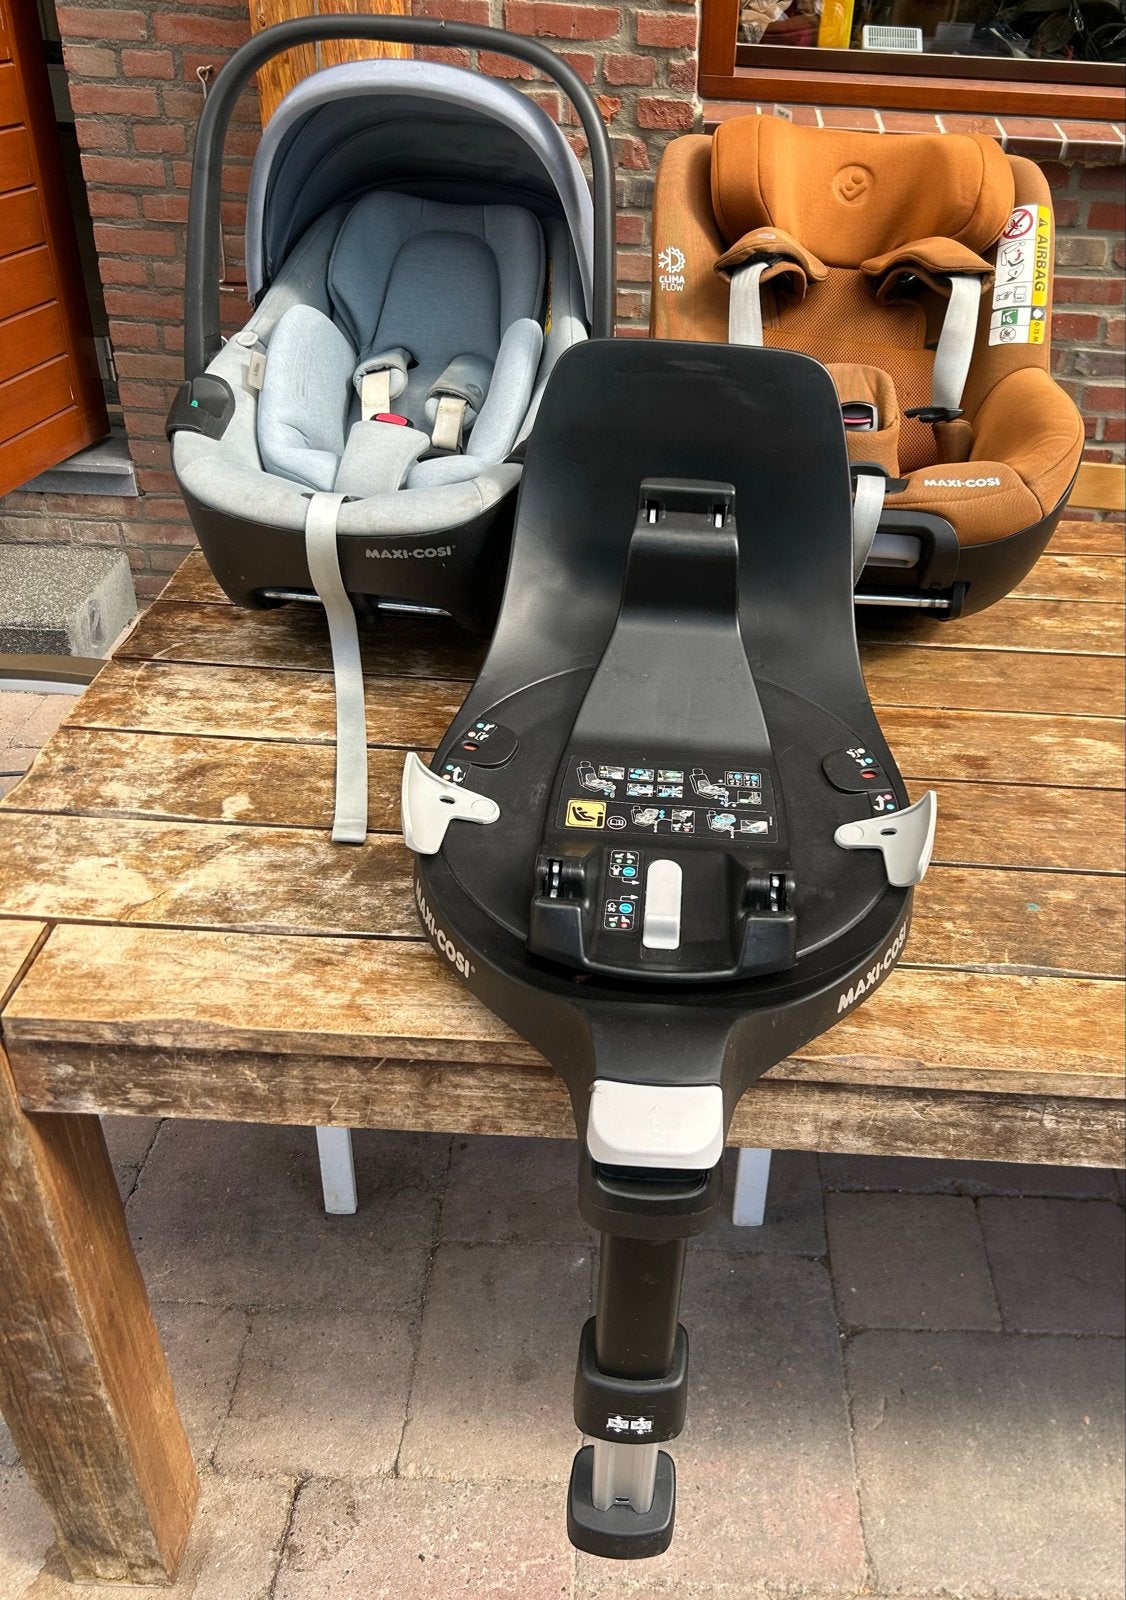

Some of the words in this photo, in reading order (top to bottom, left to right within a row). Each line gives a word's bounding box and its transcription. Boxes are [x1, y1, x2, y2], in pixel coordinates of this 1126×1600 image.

[1034, 234, 1049, 292] AIRBAG
[658, 274, 686, 284] CLIMA
[661, 283, 684, 291] FLOW
[923, 477, 1001, 488] MAXI-COSI
